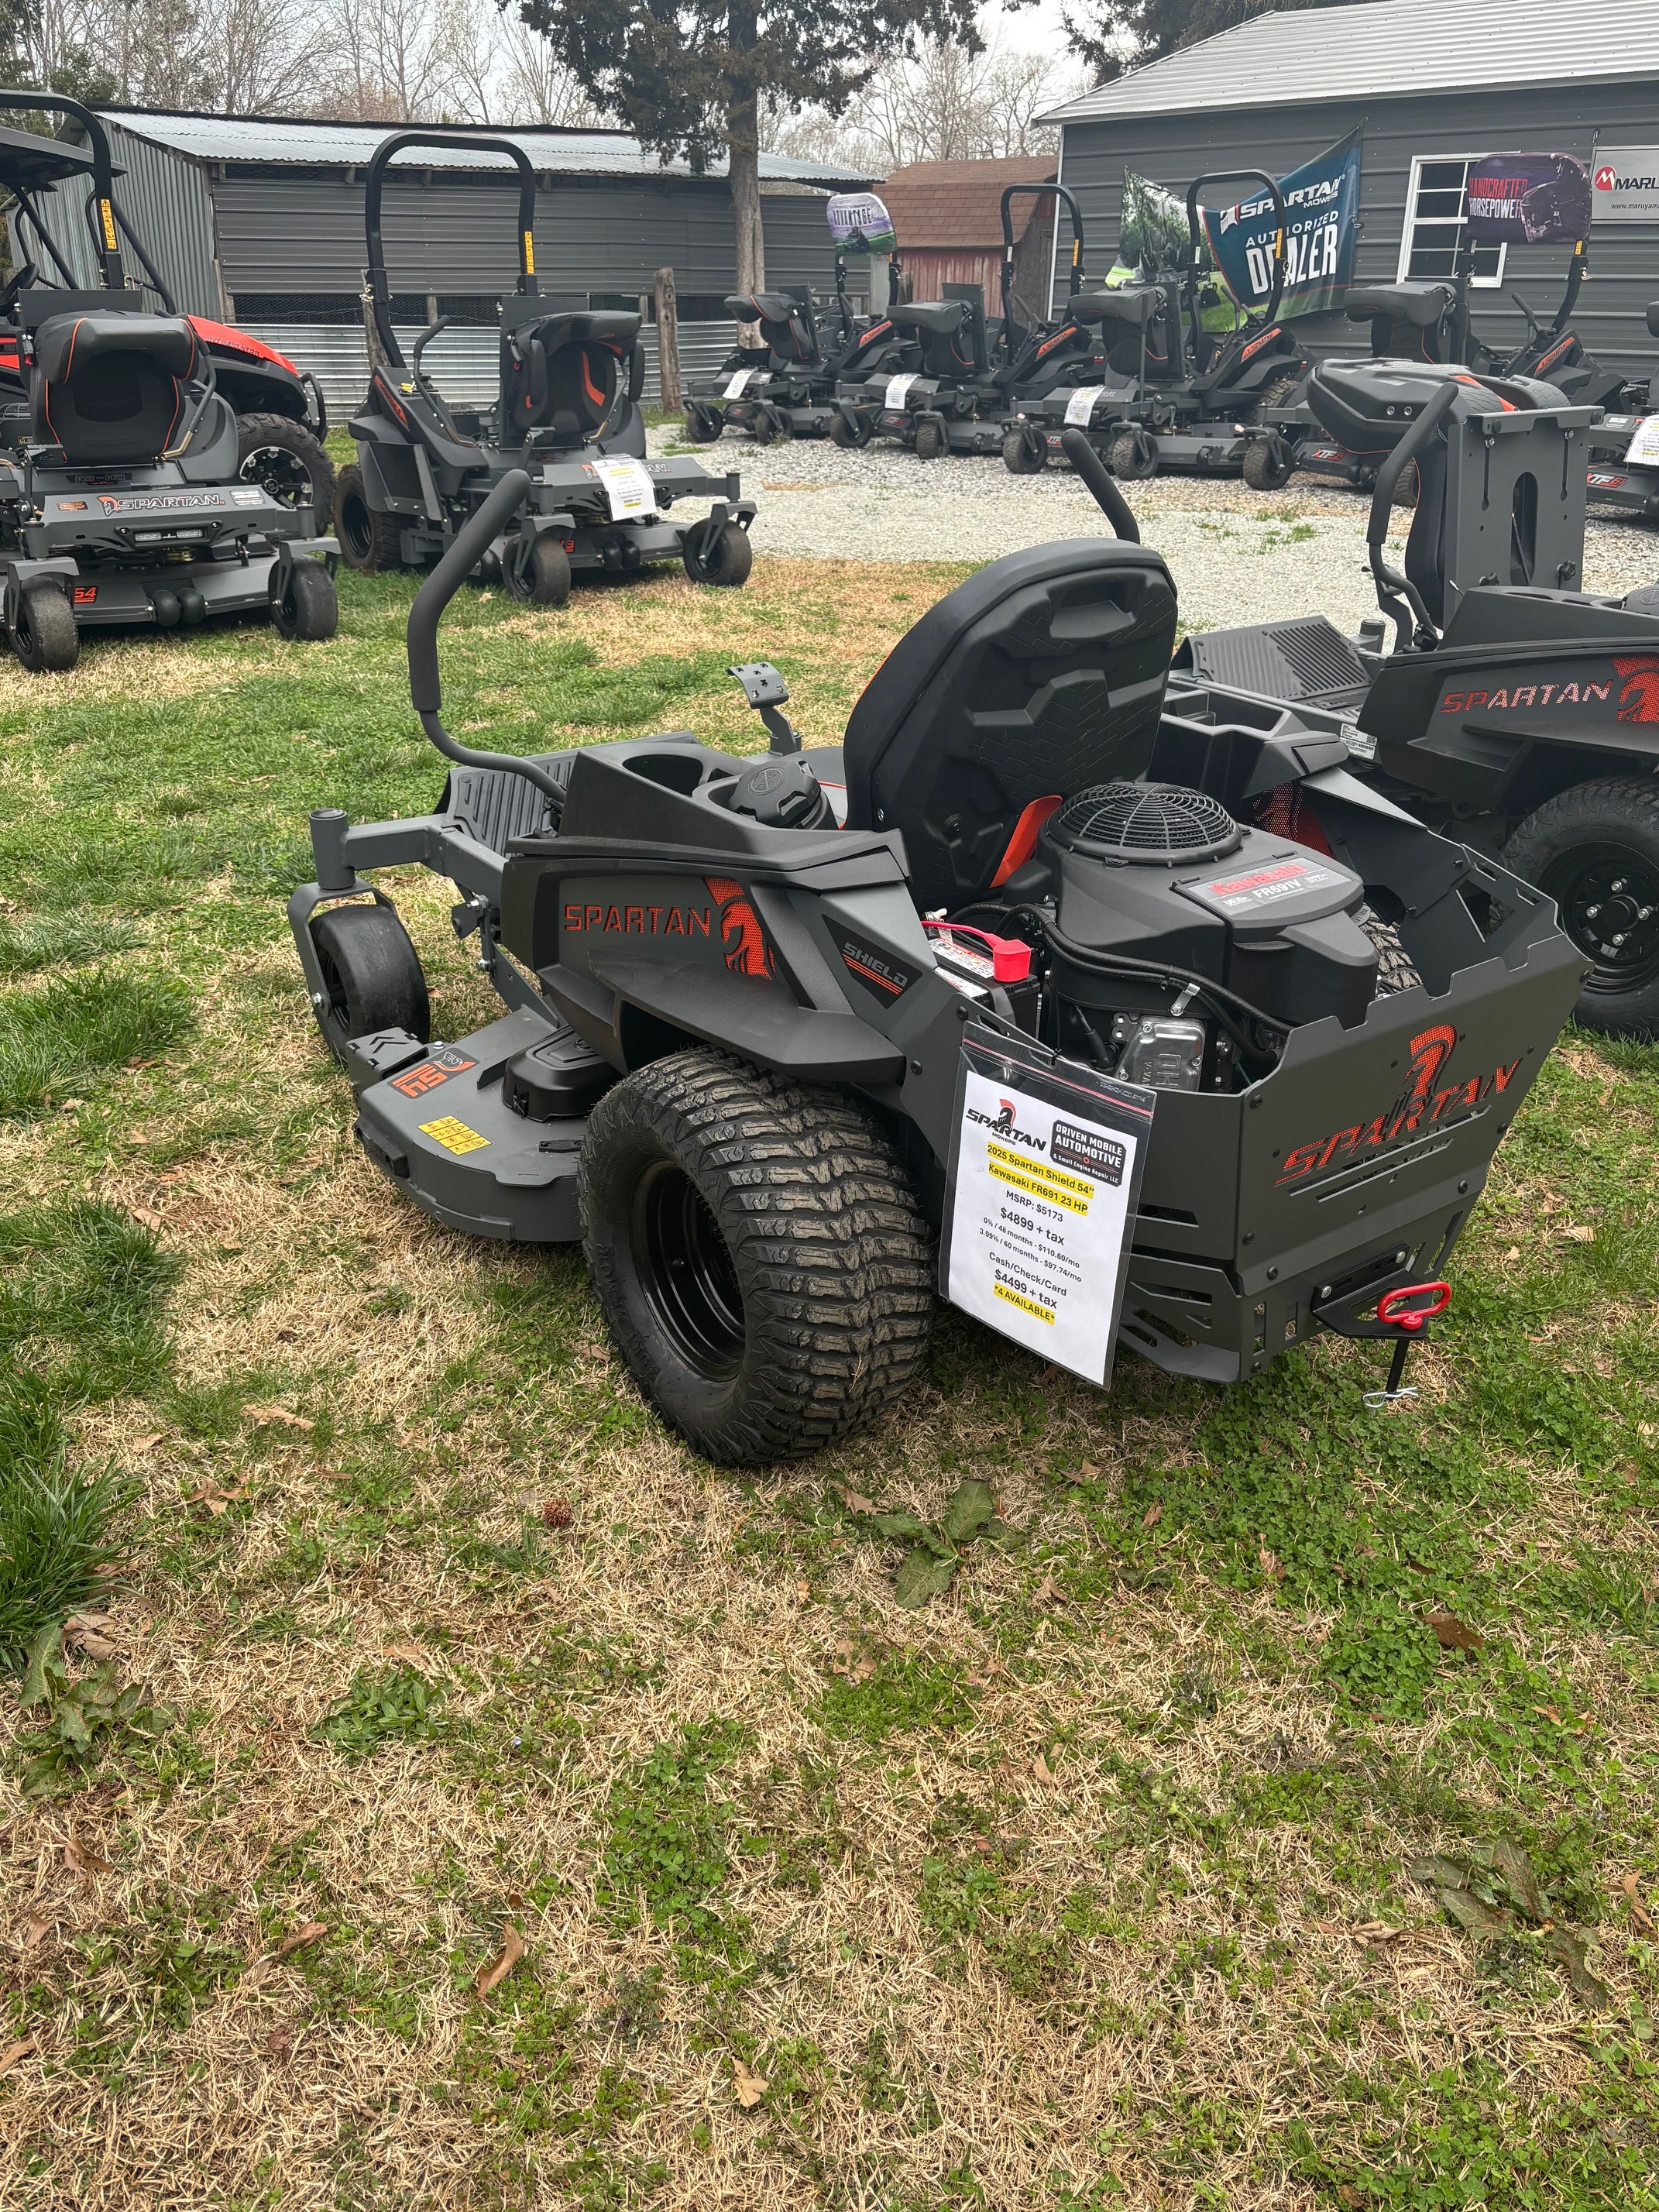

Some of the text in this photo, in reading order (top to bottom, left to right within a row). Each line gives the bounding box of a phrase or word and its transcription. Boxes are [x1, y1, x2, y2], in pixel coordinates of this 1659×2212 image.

[1468, 177, 1528, 198] HANDCRAFTED
[1440, 678, 1613, 713] SPARTAN
[1207, 862, 1308, 896] Kawasaki
[564, 903, 711, 936] SPARTAN
[841, 942, 909, 988] SHIELD
[966, 1108, 1047, 1152] SPARTAN
[991, 1132, 1016, 1146] MOWERS
[1056, 1124, 1123, 1156] DRIVEN MOBILE
[1274, 1057, 1524, 1188] SPARTAN
[987, 1145, 1007, 1160] 2025
[1008, 1155, 1044, 1177] Spartan
[1046, 1170, 1076, 1189] Shield
[1055, 1135, 1121, 1168] AUTOMOTIVE
[1058, 1155, 1073, 1165] Small
[1073, 1160, 1091, 1173] Engine
[1091, 1169, 1109, 1180] Repair
[1109, 1175, 1119, 1183] LLC
[989, 1163, 1088, 1213] Kawasaki FR691 23 HP
[1006, 1190, 1063, 1222] MSRP: $5173
[984, 1217, 994, 1227] 0%
[998, 1224, 1006, 1233] 48
[1008, 1230, 1033, 1247] months
[1038, 1244, 1080, 1269] $110.60/mo
[1001, 1207, 1034, 1231] $4899
[1046, 1229, 1065, 1246] tax
[979, 1228, 999, 1243] 3.99%
[1004, 1241, 1012, 1249] 60
[1013, 1245, 1039, 1262] months
[1044, 1259, 1082, 1283] $97.74/mo
[989, 1252, 1067, 1297] Cash/Check/Card
[994, 1269, 1027, 1293] $4499
[1039, 1293, 1057, 1309] tax
